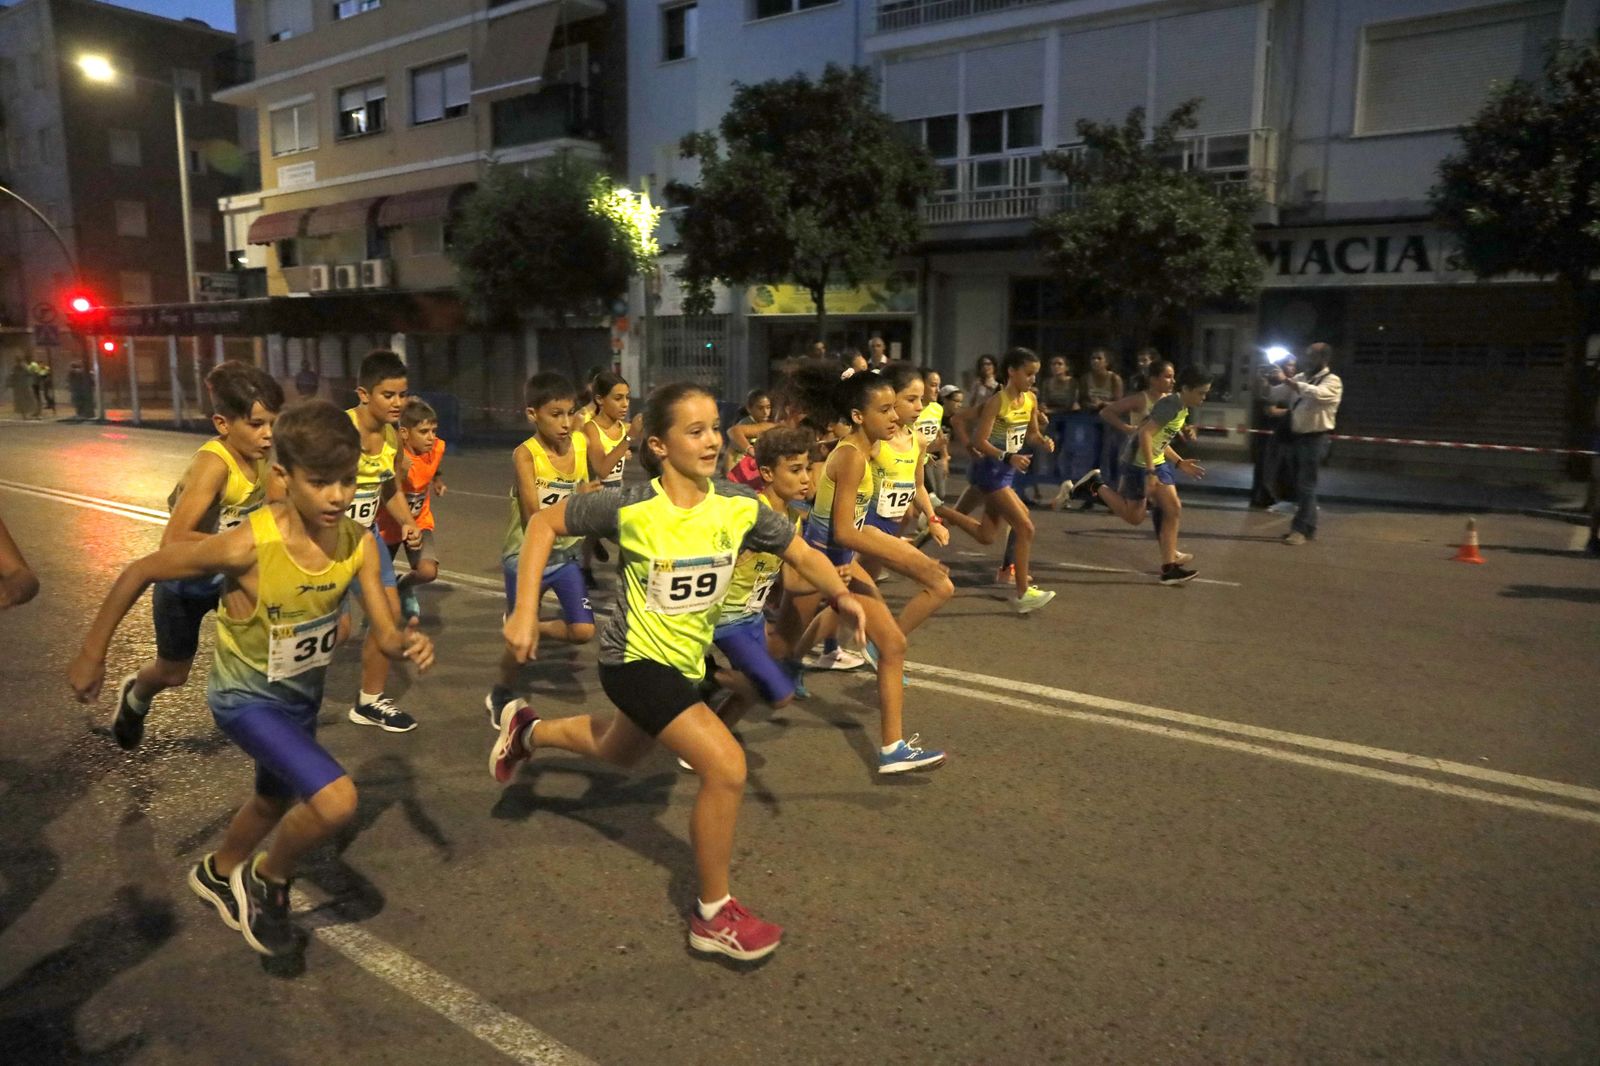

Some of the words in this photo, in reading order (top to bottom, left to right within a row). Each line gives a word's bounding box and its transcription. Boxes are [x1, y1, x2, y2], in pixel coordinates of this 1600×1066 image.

[917, 426, 938, 436] 152
[669, 572, 718, 601] 59
[294, 625, 337, 662] 30
